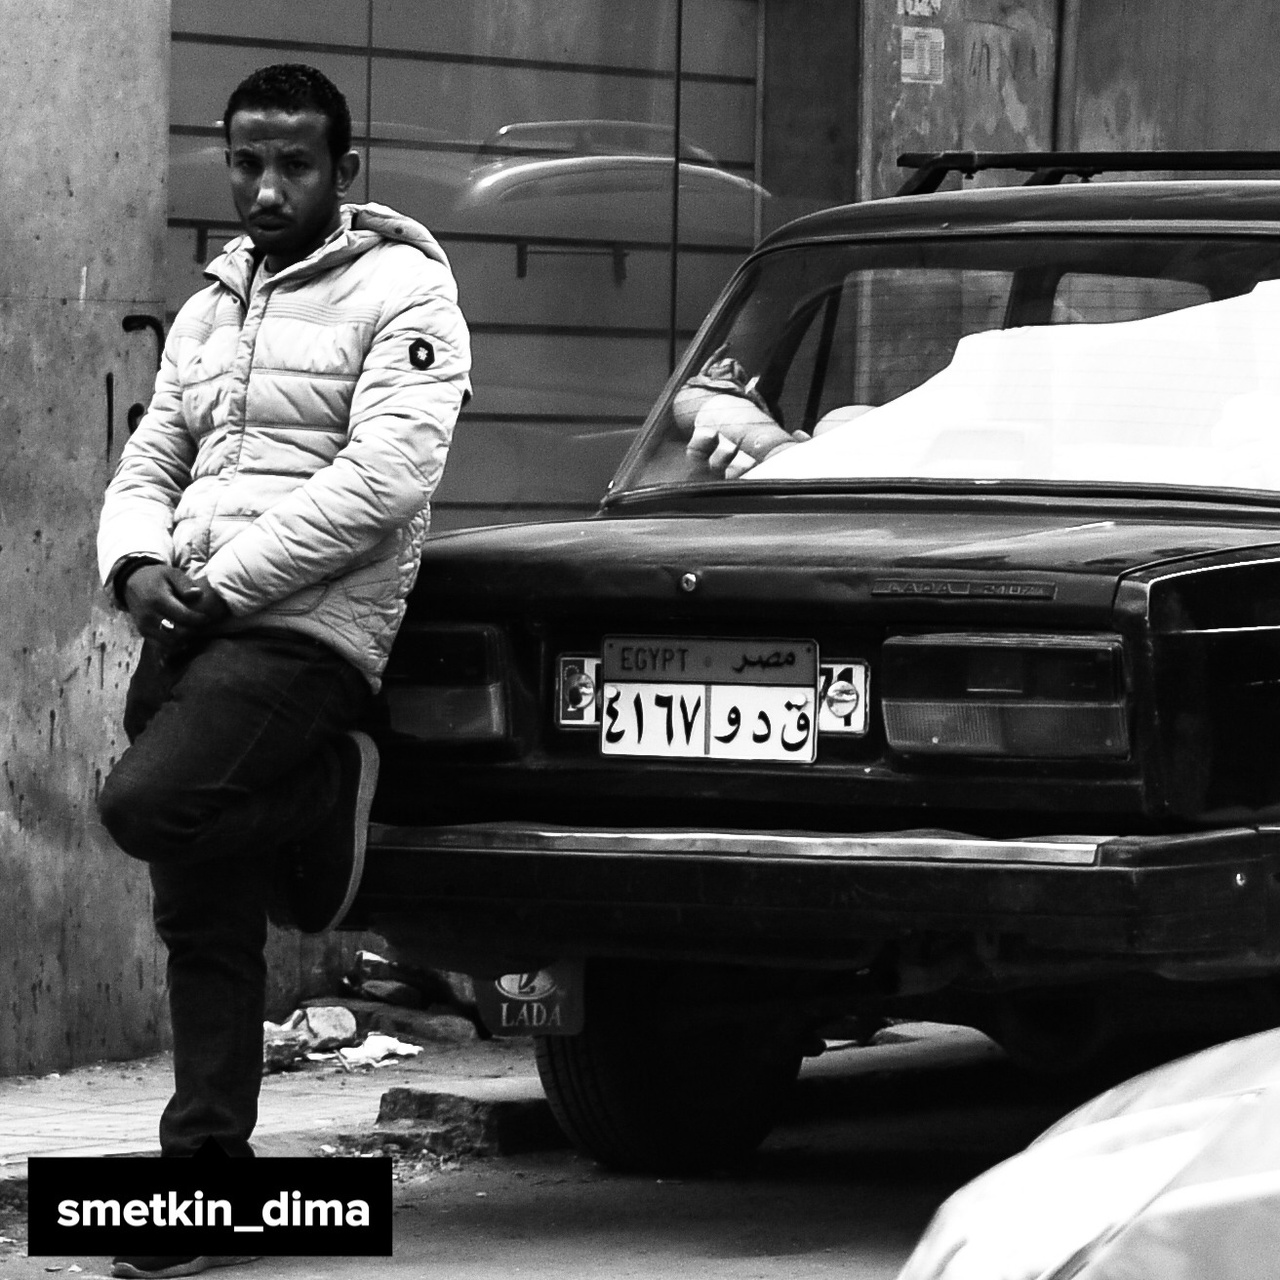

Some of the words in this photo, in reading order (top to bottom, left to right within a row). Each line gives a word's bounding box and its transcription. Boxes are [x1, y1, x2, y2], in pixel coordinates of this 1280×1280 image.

[620, 646, 690, 671] EGYPT
[732, 648, 796, 674] مصر
[605, 690, 701, 746] ٤١٦٧
[500, 1002, 561, 1027] LADA
